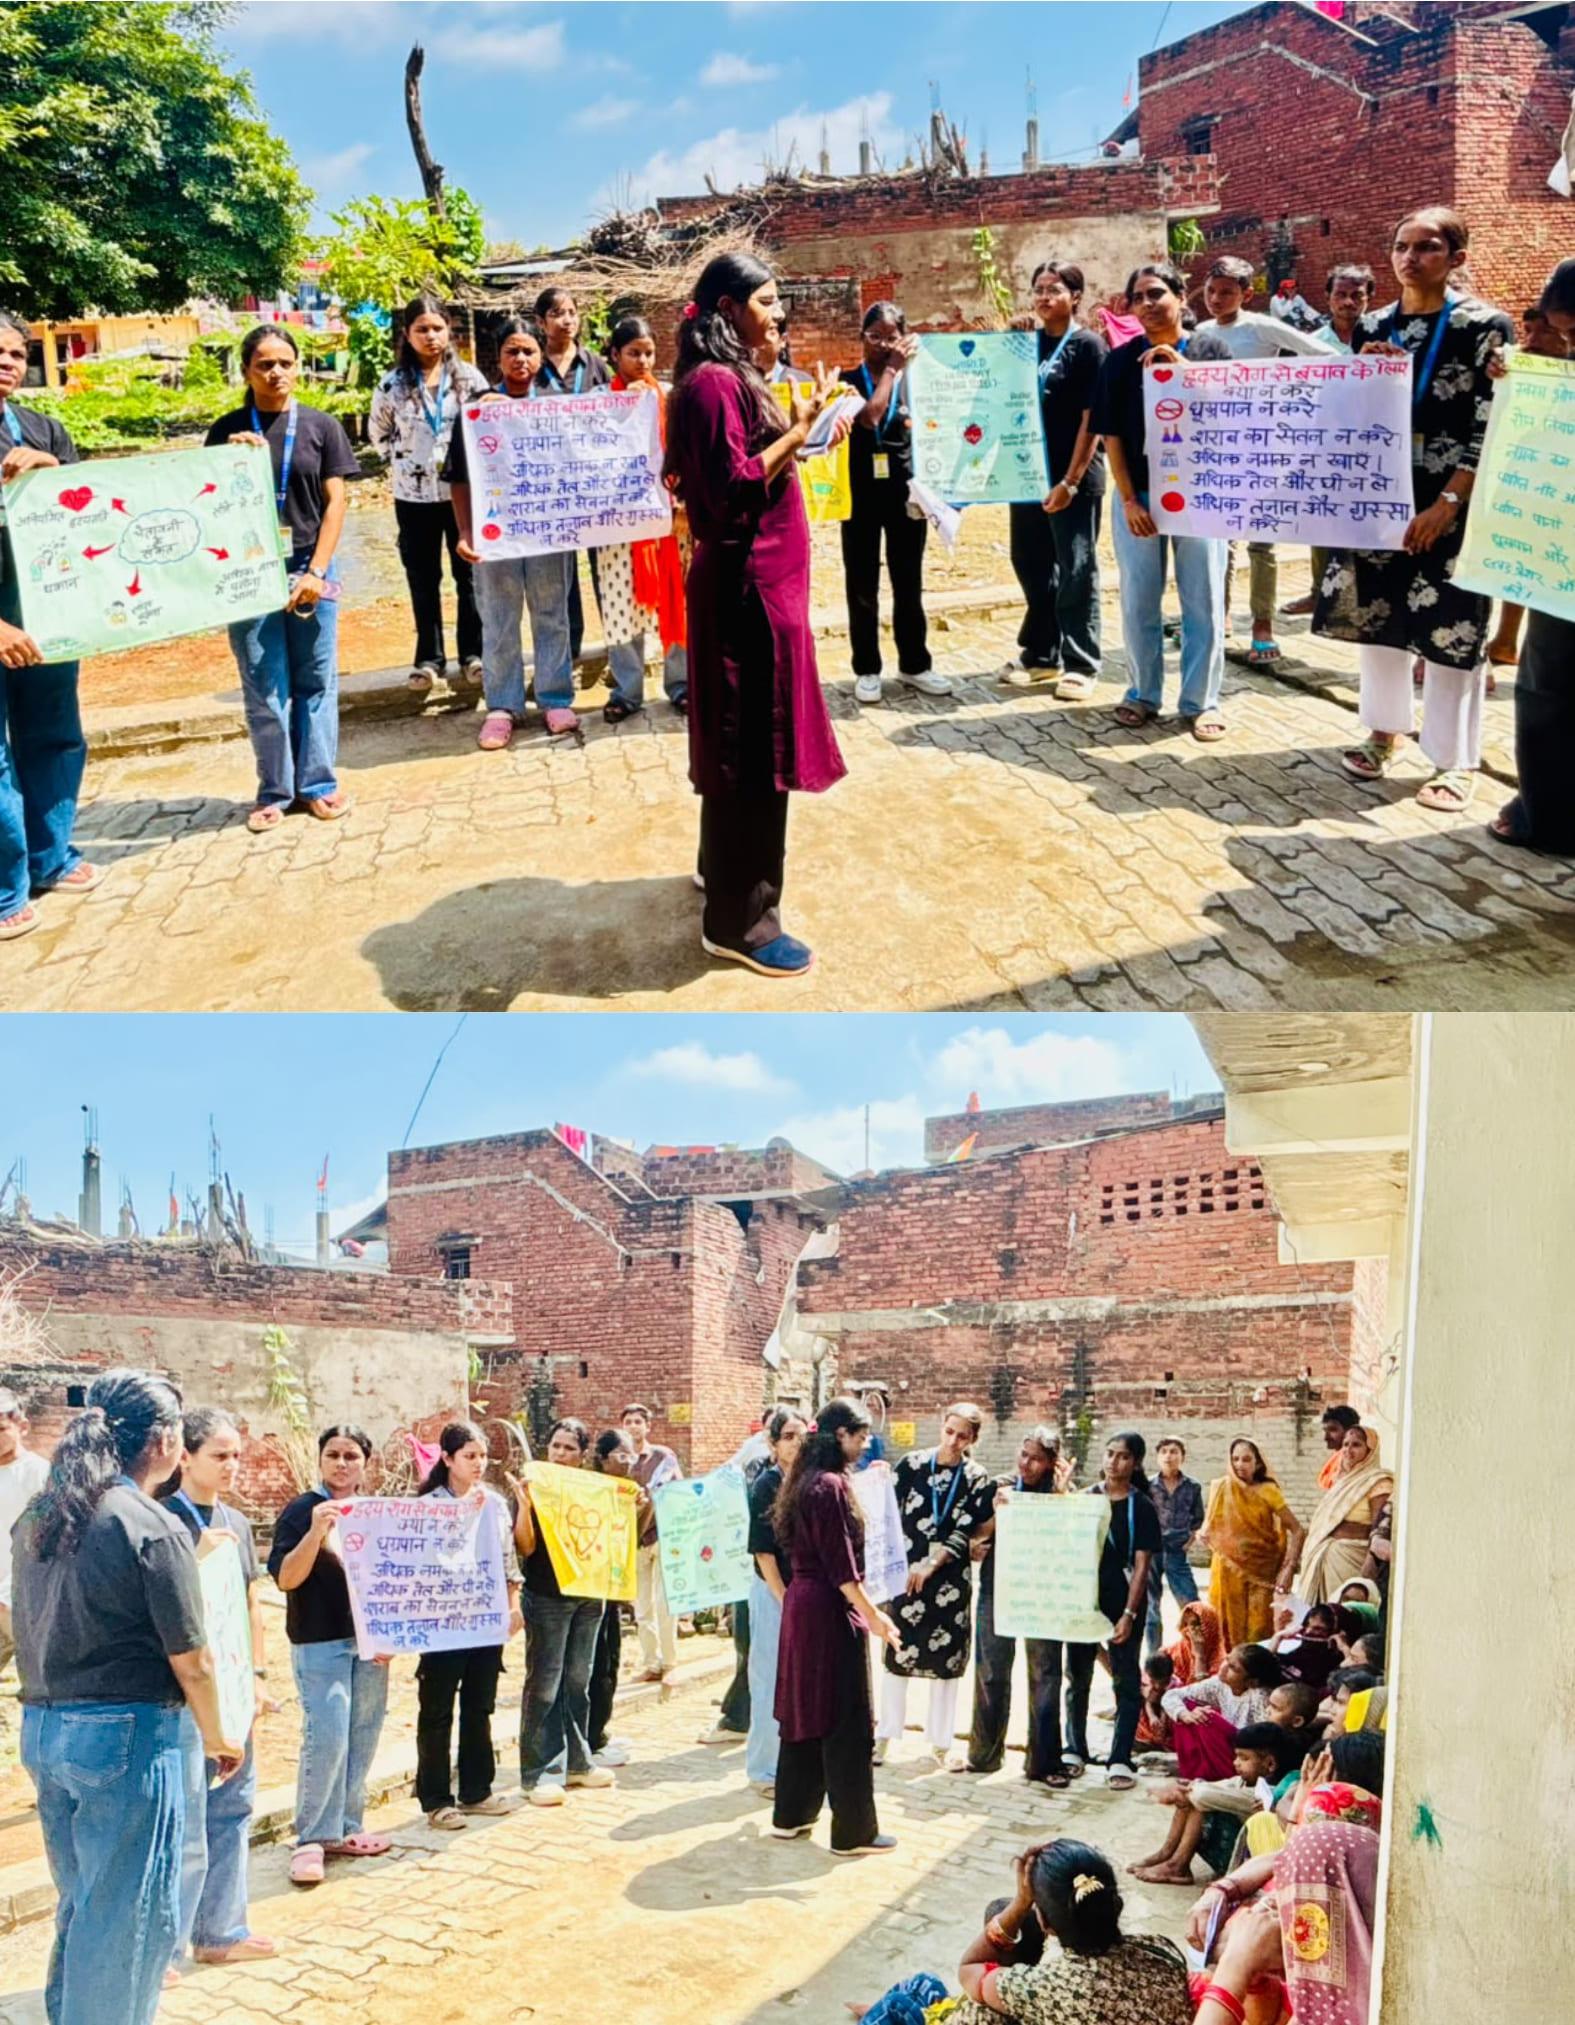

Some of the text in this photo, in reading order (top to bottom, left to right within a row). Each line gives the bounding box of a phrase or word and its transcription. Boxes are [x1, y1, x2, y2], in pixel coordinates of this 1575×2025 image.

[1231, 363, 1270, 383] रोग
[1270, 364, 1292, 381] से
[1294, 364, 1351, 381] बचाव
[1351, 358, 1374, 380] के
[1258, 385, 1277, 399] न
[1258, 401, 1279, 417] न
[563, 415, 578, 429] न
[572, 433, 587, 447] न
[1190, 430, 1241, 446] शराब
[1243, 427, 1275, 447] का
[1275, 422, 1329, 446] सेवन
[1334, 428, 1358, 445] न
[1188, 448, 1244, 466] अधिक
[1246, 452, 1296, 467] नमक
[1298, 453, 1321, 468] न
[1189, 469, 1247, 489] अधिक
[1244, 470, 1279, 489] तेल
[1282, 469, 1318, 490] और
[1320, 472, 1350, 491] घी
[1348, 477, 1369, 491] न
[551, 497, 571, 511] का
[1189, 492, 1410, 522] अधिक तनाव और गुस्सा
[1226, 515, 1244, 531] न
[540, 534, 553, 545] न
